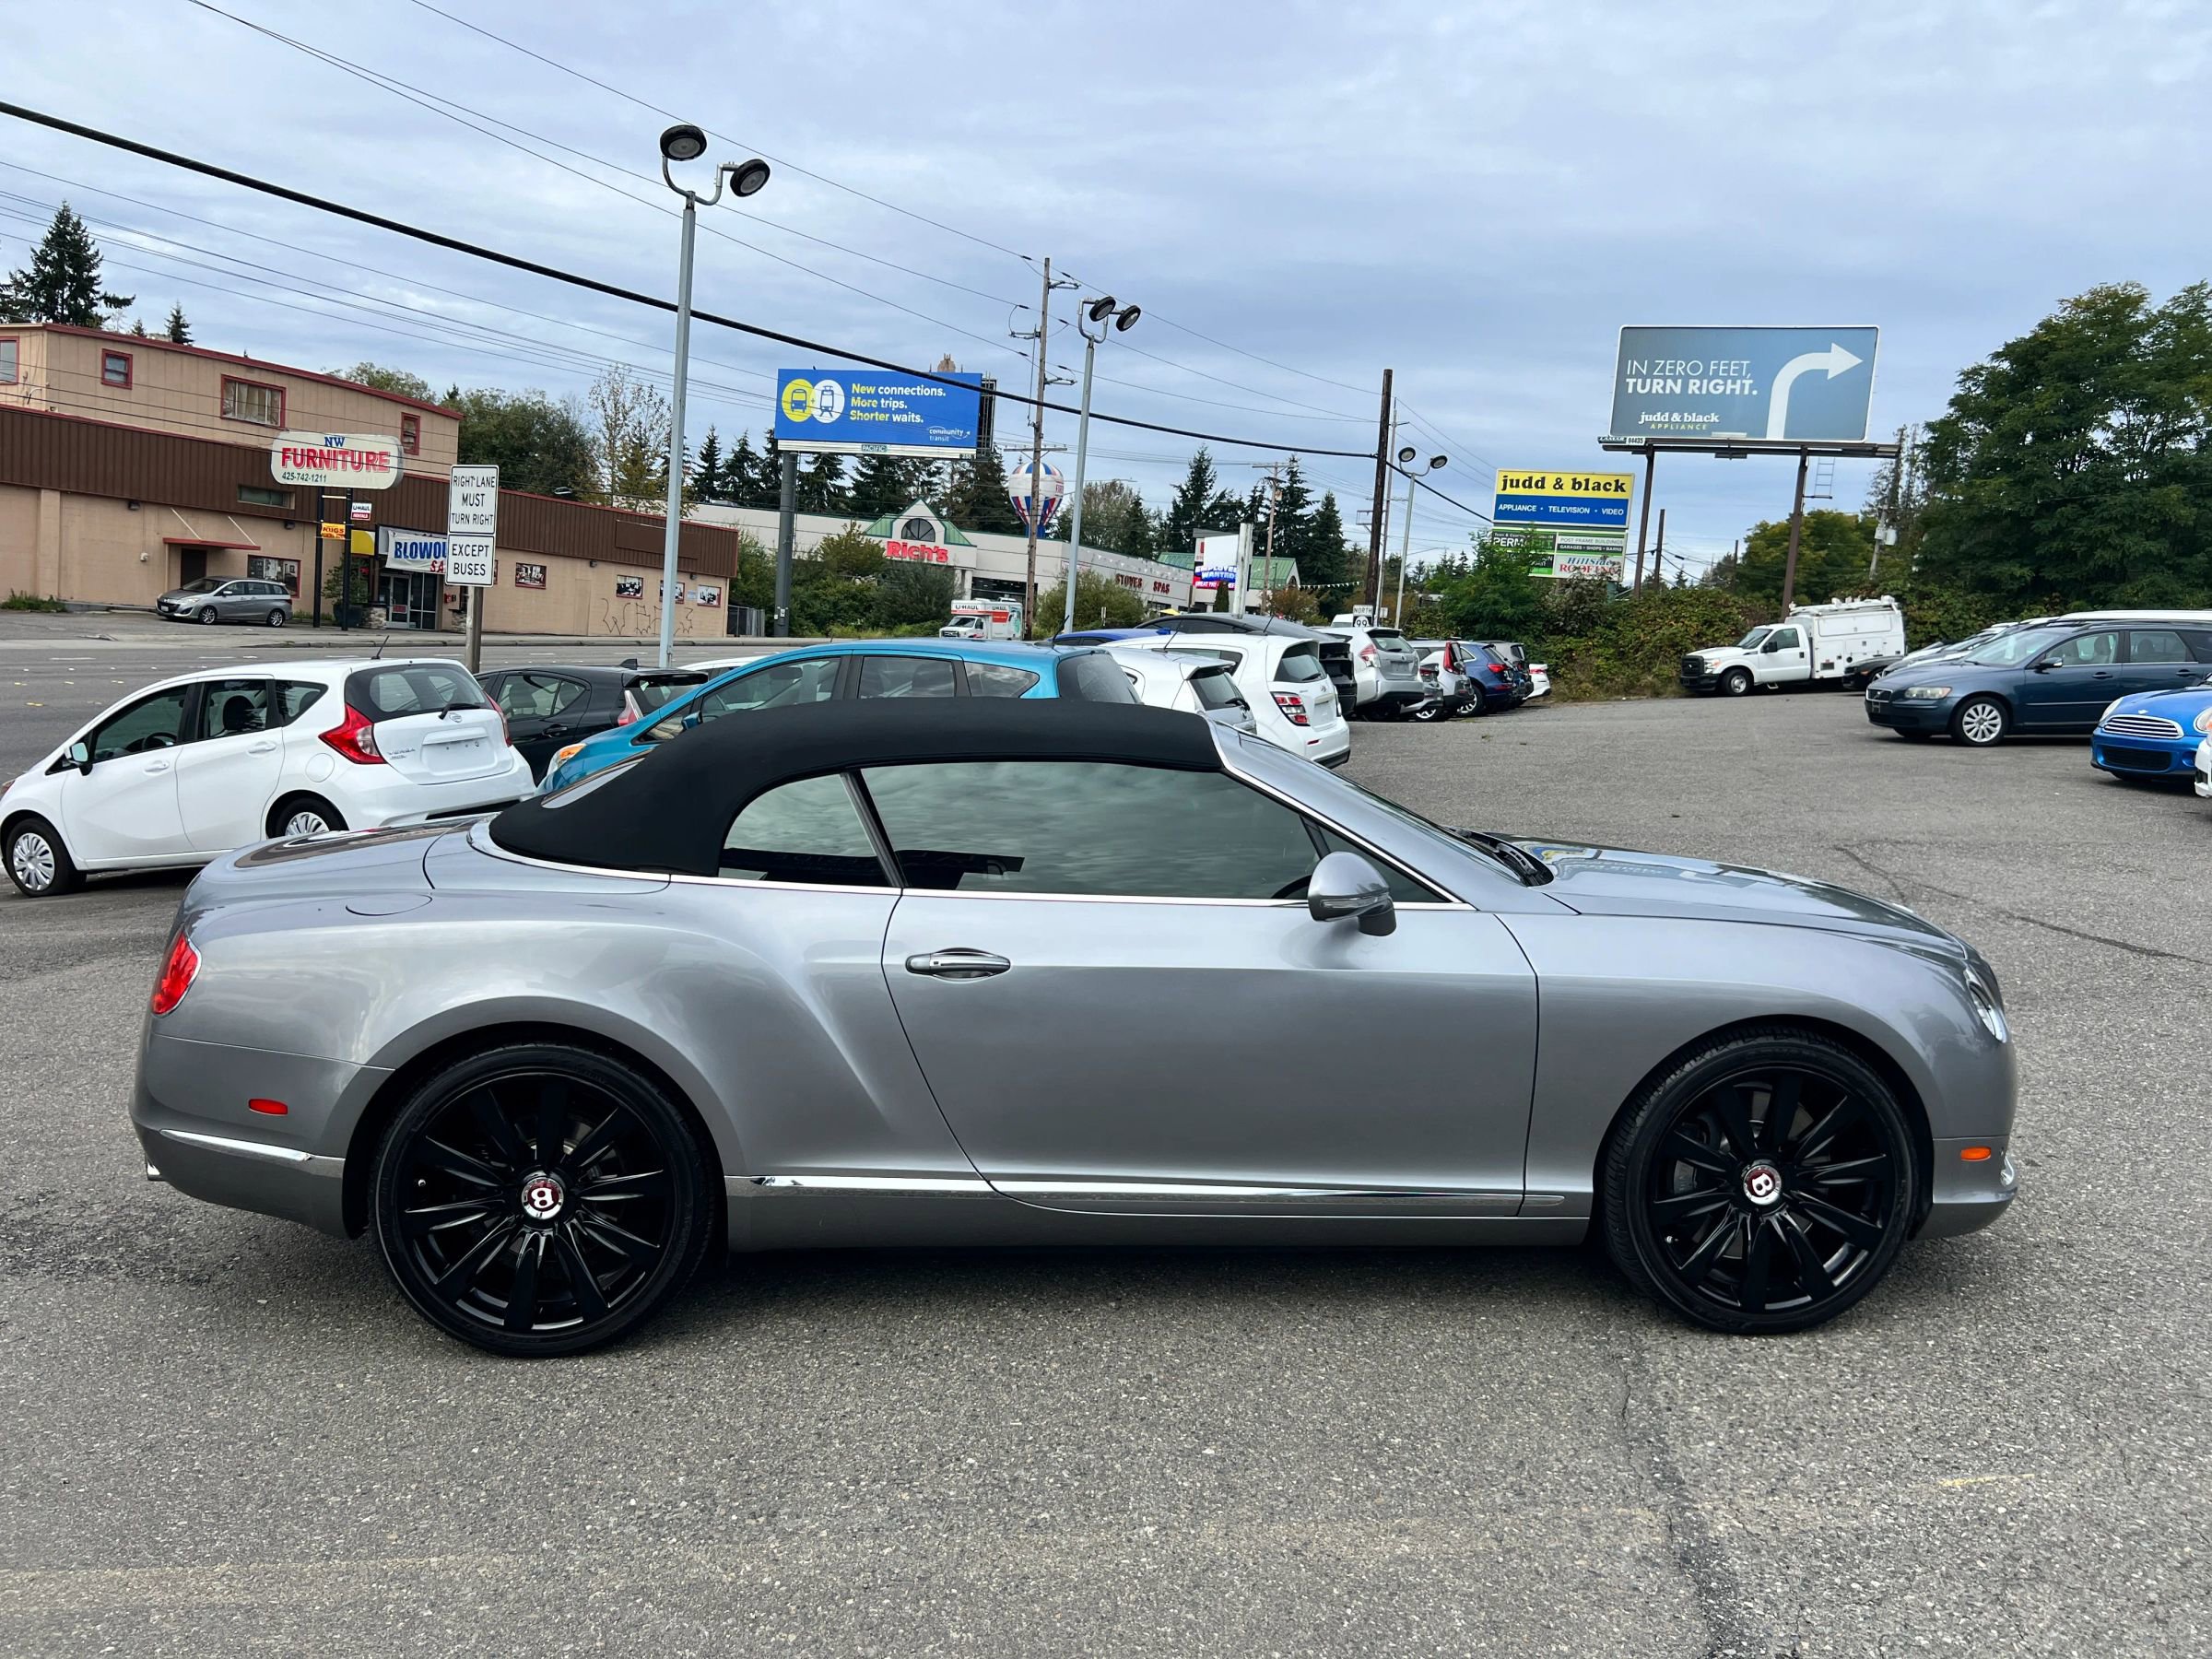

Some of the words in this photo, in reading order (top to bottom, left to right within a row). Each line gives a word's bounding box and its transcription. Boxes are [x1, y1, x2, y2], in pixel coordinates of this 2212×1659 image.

[1627, 359, 1648, 375] IN
[1653, 359, 1703, 376] ZERO
[1709, 360, 1751, 379] FEET,
[852, 383, 876, 394] New
[877, 384, 947, 396] connections.
[1626, 378, 1685, 394] TURN
[1688, 379, 1758, 395] RIGHT.
[851, 397, 877, 407] More
[880, 397, 908, 411] trips.
[850, 410, 889, 421] Shorter
[892, 411, 924, 423] waits.
[1638, 411, 1669, 424] judd
[1670, 413, 1682, 422] &
[1684, 412, 1720, 423] black
[929, 428, 964, 436] community
[324, 436, 346, 447] NW
[280, 447, 391, 474] FURNITURE
[282, 471, 327, 483] 425-742-1211
[453, 476, 475, 488] RIGHT
[476, 477, 495, 488] LANE
[1501, 475, 1547, 491] judd
[1552, 477, 1564, 490] &
[1571, 477, 1627, 493] black
[461, 493, 485, 507] MUST
[1498, 504, 1537, 512] APPLIANCE
[1547, 506, 1590, 514] TELEVISION
[452, 513, 470, 524] TURN
[472, 514, 494, 526] RIGHT
[394, 541, 447, 559] BLOWOU
[452, 544, 490, 557] EXCEPT
[885, 541, 949, 563] Rich's
[453, 562, 486, 577] BUSES
[1201, 571, 1235, 580] WANTED
[1115, 573, 1143, 589] STOVES
[1153, 581, 1171, 594] SPAS
[531, 1187, 555, 1209] B
